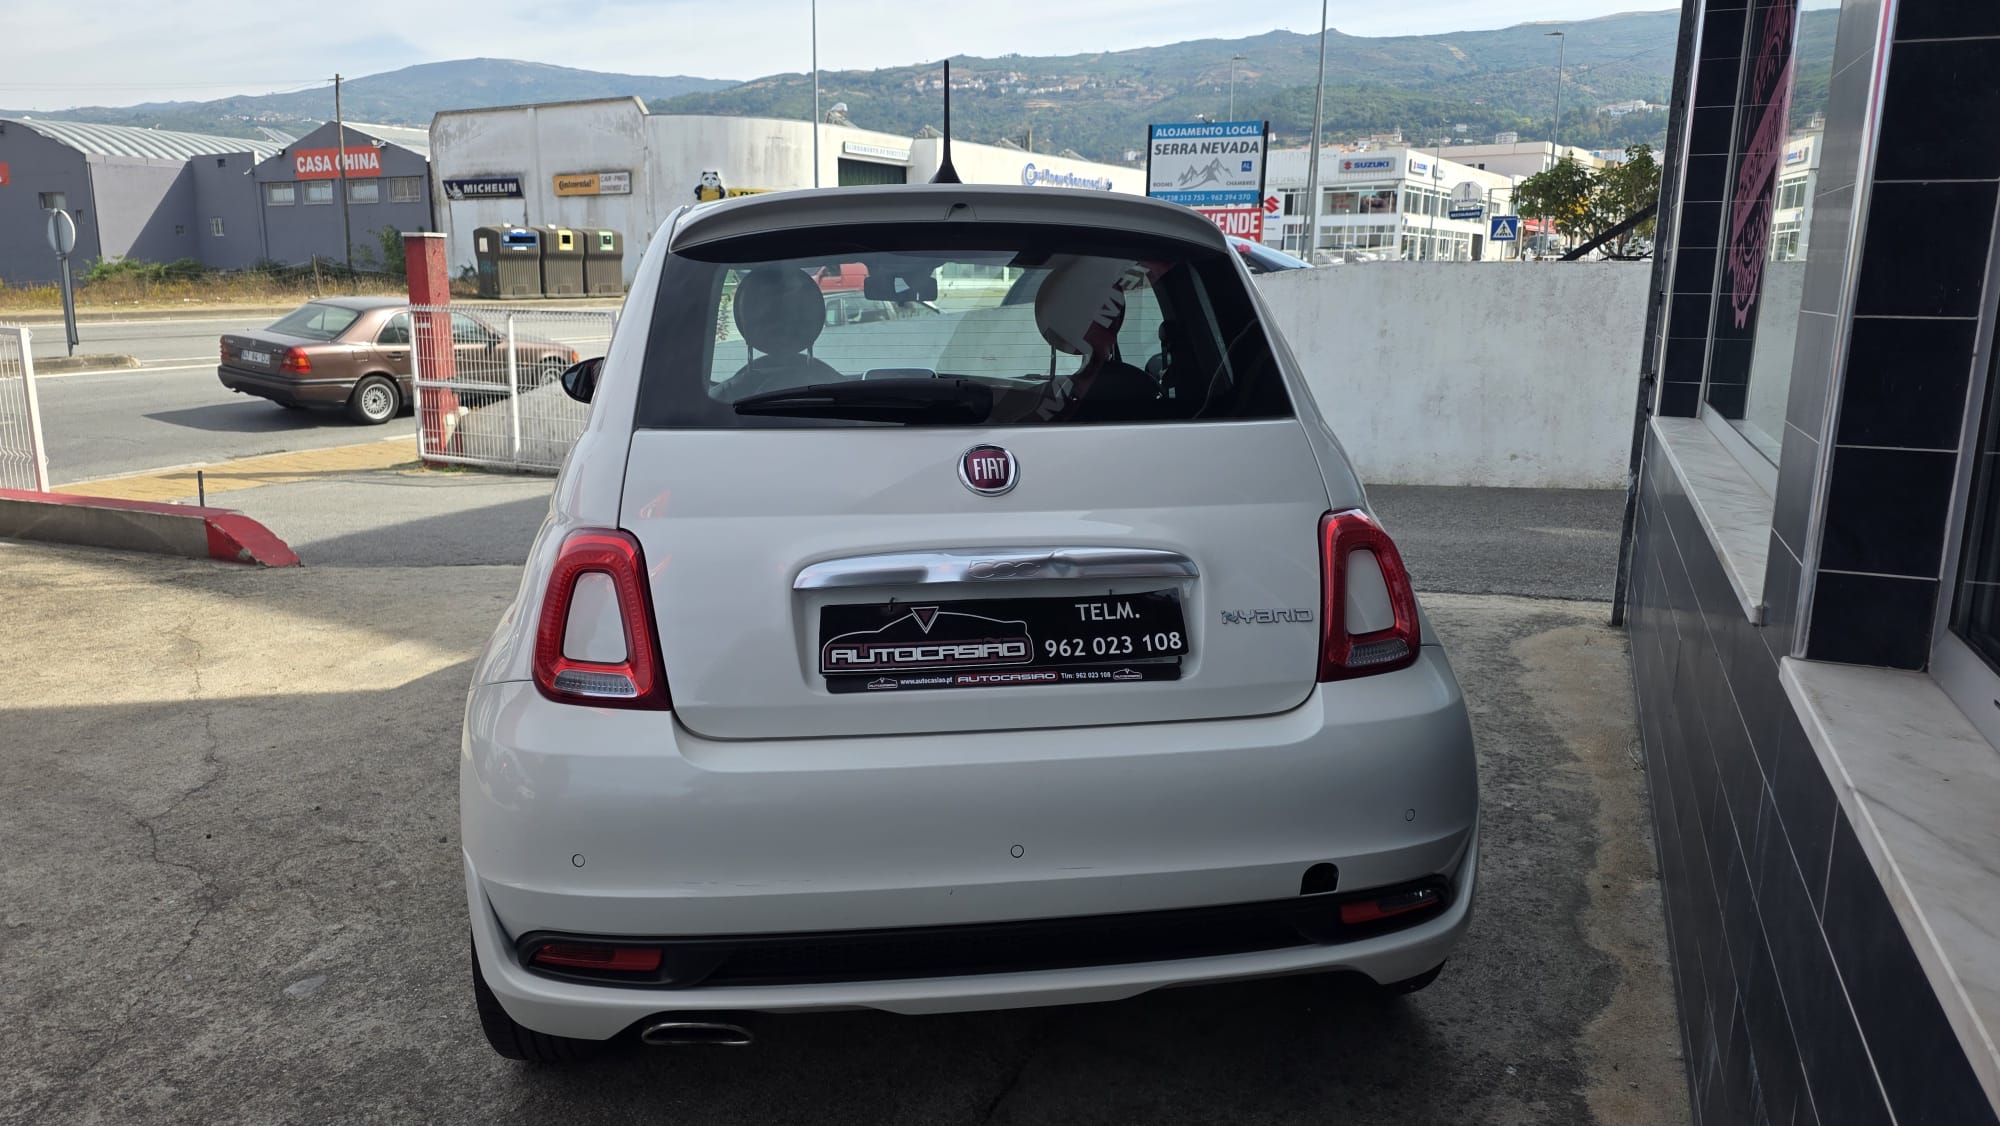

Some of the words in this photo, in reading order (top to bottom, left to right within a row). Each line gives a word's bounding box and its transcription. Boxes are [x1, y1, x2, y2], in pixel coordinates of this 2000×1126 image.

[1155, 126, 1223, 137] ALOJAMENTO
[1226, 125, 1259, 136] LOCAL
[1154, 142, 1198, 156] SERRA
[1200, 140, 1260, 155] NEVADA
[296, 155, 333, 173] CASA
[1354, 160, 1390, 169] SUZUKI
[463, 182, 517, 194] MICHELIN
[972, 457, 1006, 480] FIAT
[1075, 601, 1141, 621] TELM.
[1044, 638, 1086, 658] 962
[1092, 635, 1134, 655] 023
[1142, 631, 1182, 652] 108
